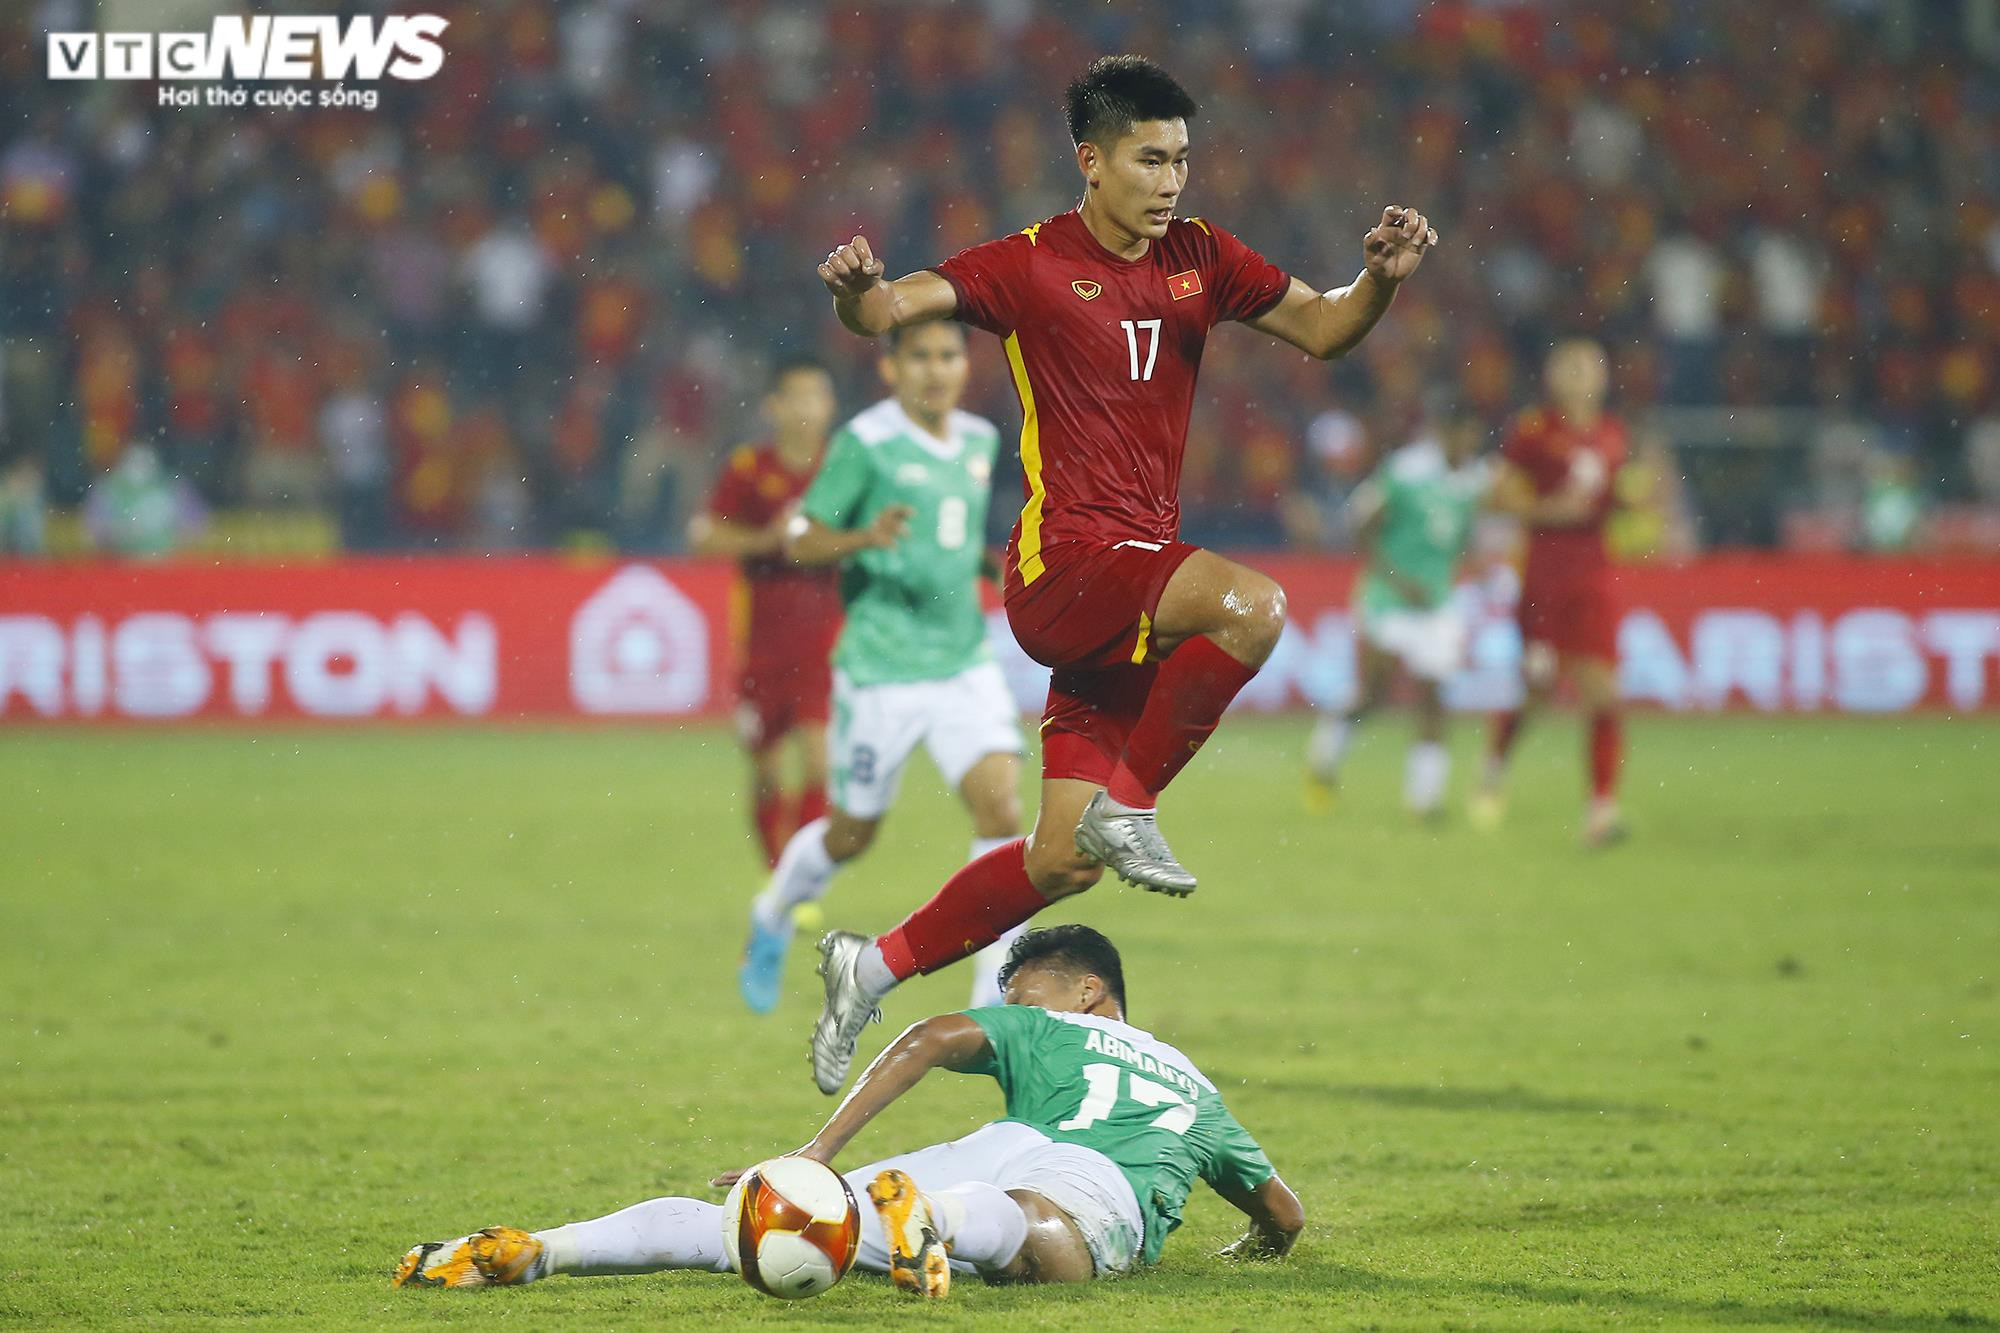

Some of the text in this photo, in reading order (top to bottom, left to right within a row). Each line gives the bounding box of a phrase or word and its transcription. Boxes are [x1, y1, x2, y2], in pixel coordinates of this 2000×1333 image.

[1120, 318, 1163, 382] 17
[850, 742, 877, 788] 8
[1057, 1062, 1197, 1136] 17
[1084, 1029, 1199, 1101] ABIMANYU
